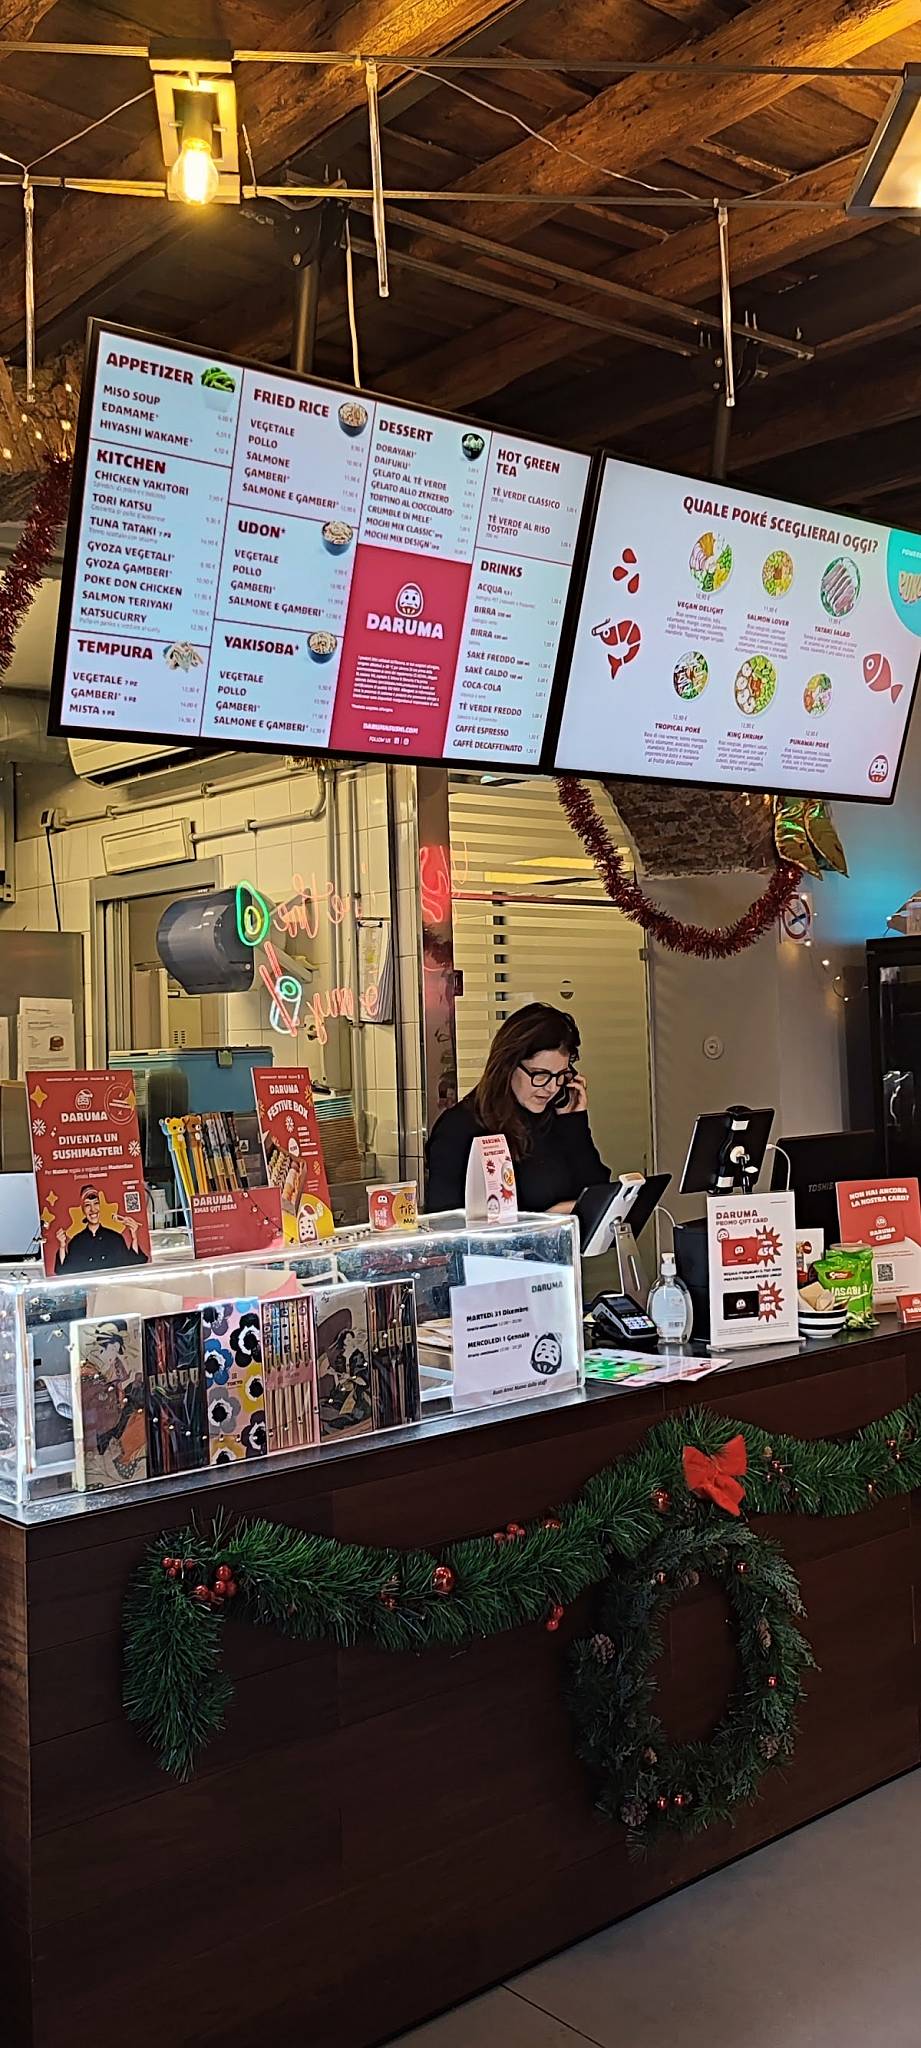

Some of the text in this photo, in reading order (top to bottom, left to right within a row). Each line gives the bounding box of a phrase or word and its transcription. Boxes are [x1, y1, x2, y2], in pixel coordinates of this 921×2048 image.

[106, 352, 194, 385] APPETIZER
[104, 385, 160, 405] MISO SOUP
[254, 388, 329, 417] FRIED RICE
[100, 420, 142, 436] HIYASHI
[250, 419, 295, 437] VEGETALE
[379, 420, 433, 442] DESSERT
[248, 435, 278, 448] POLLO
[97, 449, 166, 474] KITCHEN
[247, 451, 290, 468] SALMONE
[498, 449, 560, 474] HOT GREEN
[496, 463, 517, 477] TEA
[95, 470, 140, 486] CHICKEN
[142, 479, 189, 495] YAKITORI
[373, 468, 400, 481] GELATO
[402, 473, 412, 483] AL
[424, 480, 447, 491] VERDE
[242, 483, 286, 499] SALMONE
[371, 481, 449, 503] GELATO ALLO ZENZERO
[93, 493, 152, 512] TORI KATSU
[370, 493, 400, 505] TORTINO
[402, 498, 411, 507] AL
[503, 490, 526, 502] VERDE
[528, 496, 560, 509] CLASSICO
[368, 505, 400, 518] CRUMBLE
[403, 512, 410, 520] DI
[90, 517, 119, 529] TUNA
[122, 522, 157, 535] TATAKI
[366, 517, 390, 528] MOCHI
[392, 522, 404, 531] MIX
[487, 524, 518, 536] TOSTATO
[499, 517, 521, 528] VERDE
[524, 523, 532, 531] AL
[534, 525, 550, 534] RISO
[683, 496, 729, 519] QUALE
[732, 507, 767, 528] POKÉ
[770, 517, 840, 544] SCEGLIERAI
[843, 534, 878, 554] OGGI?
[364, 530, 388, 540] MOCHI
[390, 534, 402, 544] MIX
[88, 541, 122, 554] GYOZA
[235, 549, 279, 564] VEGETALE
[86, 558, 120, 570] GYOZA
[481, 561, 523, 577] DRINKS
[232, 565, 262, 577] POLLO
[84, 574, 182, 596] POKE DON CHICKEN
[478, 583, 502, 594] ACQUA
[82, 591, 172, 611] SALMON TERIYAKI
[228, 596, 272, 610] SALMONE
[474, 606, 496, 616] BIRRA
[678, 601, 724, 615] VEGAN DELIGHT
[81, 607, 147, 623] KATSUCURRY
[747, 613, 789, 626] SALMON LOVER
[366, 612, 444, 640] DARUMA
[815, 626, 851, 638] TATAKI SALAD
[471, 628, 492, 638] BIRRA
[78, 640, 153, 660] TEMPURA
[487, 653, 515, 664] FREDDO
[73, 672, 123, 685] VEGETALE
[220, 670, 264, 683] VEGETALE
[485, 668, 508, 678] CALDO
[218, 686, 247, 696] POLLO
[462, 680, 502, 692] COCA-COLA
[70, 704, 99, 714] MISTA
[470, 704, 492, 713] VERDE
[494, 706, 522, 716] FREDDO
[214, 716, 256, 728] SALMONE
[259, 720, 264, 728] E
[655, 723, 683, 731] TROPICAL
[477, 727, 509, 736] ESPRESSO
[727, 731, 741, 739] KING
[475, 741, 523, 752] DECAFFEINATO
[269, 1085, 299, 1094] DARUMA
[61, 1111, 108, 1122] DARUMA
[267, 1100, 308, 1121] FESTIVE BOX
[59, 1133, 118, 1145] DIVENTA UN
[849, 1187, 907, 1200] NON HAI ANCORA
[193, 1195, 233, 1207] DARUMA
[851, 1200, 860, 1208] LA
[861, 1196, 887, 1205] NOSTRA
[716, 1210, 758, 1219] DARUMA
[869, 1227, 896, 1236] DARUMA
[532, 1281, 563, 1293] DARUMA
[503, 1307, 528, 1315] Dicembre
[507, 1332, 530, 1341] Gennaio
